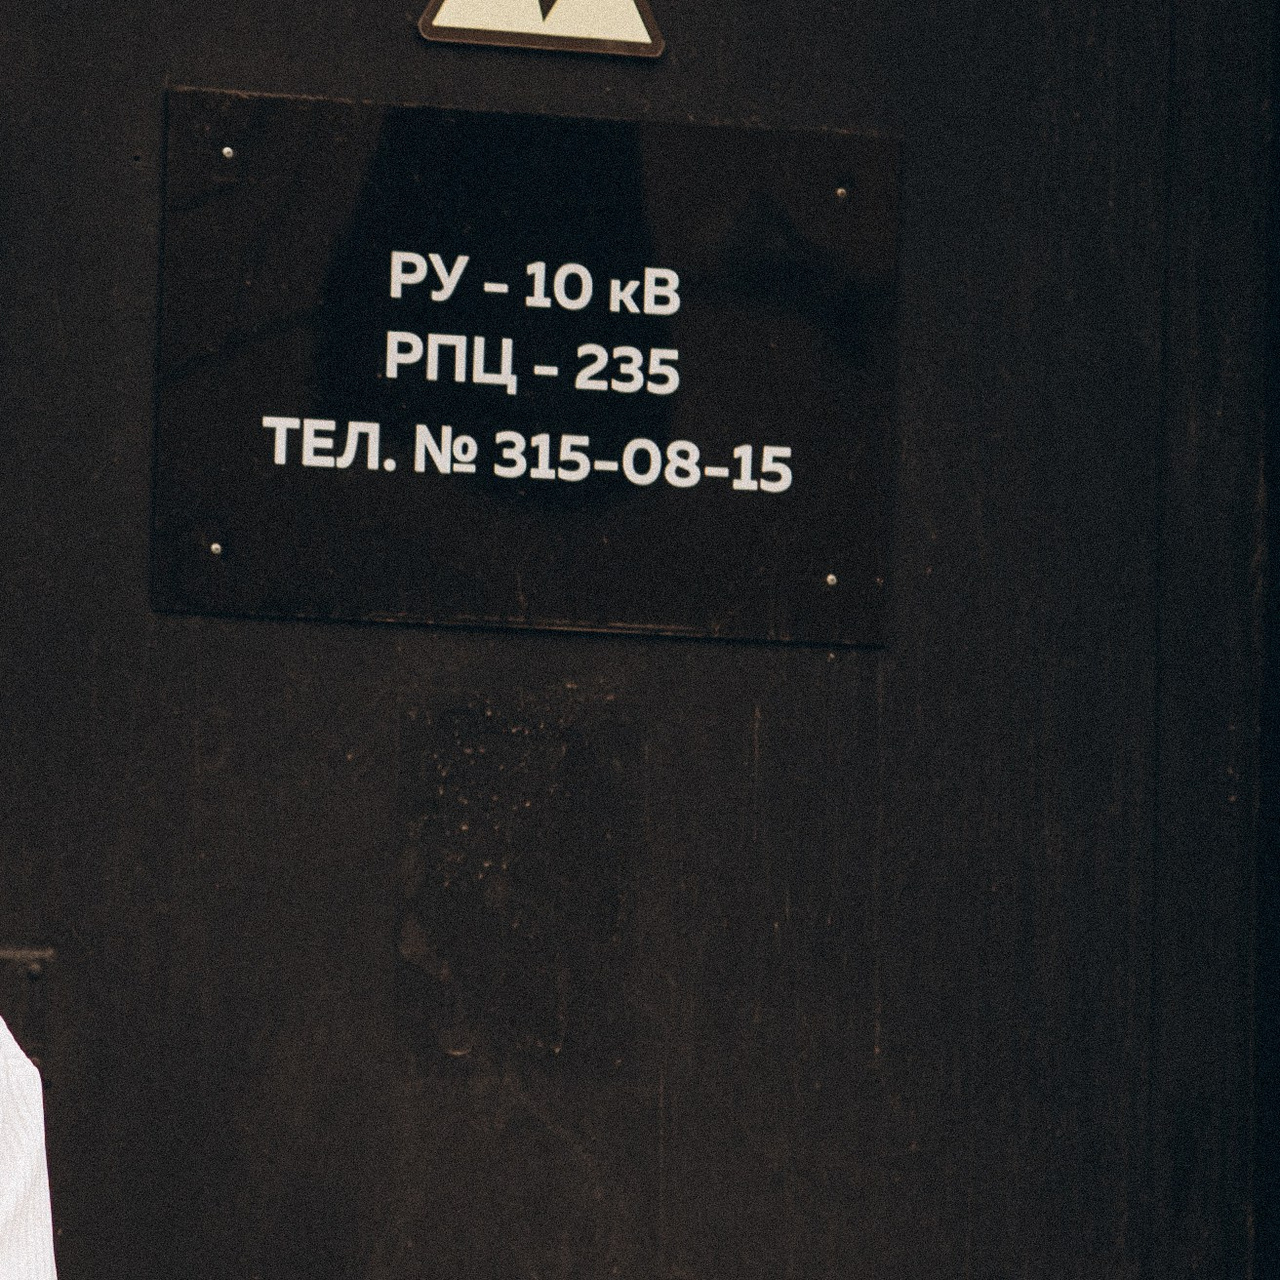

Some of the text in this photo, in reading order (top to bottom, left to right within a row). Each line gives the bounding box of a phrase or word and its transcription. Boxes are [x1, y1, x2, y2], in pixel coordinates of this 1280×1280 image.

[390, 250, 470, 302] РУ
[525, 261, 594, 311] 10
[609, 267, 681, 316] кВ
[385, 330, 518, 396] РПЦ
[574, 343, 680, 395] 235
[262, 415, 793, 493] ТЕЛ. № 315-08-15
